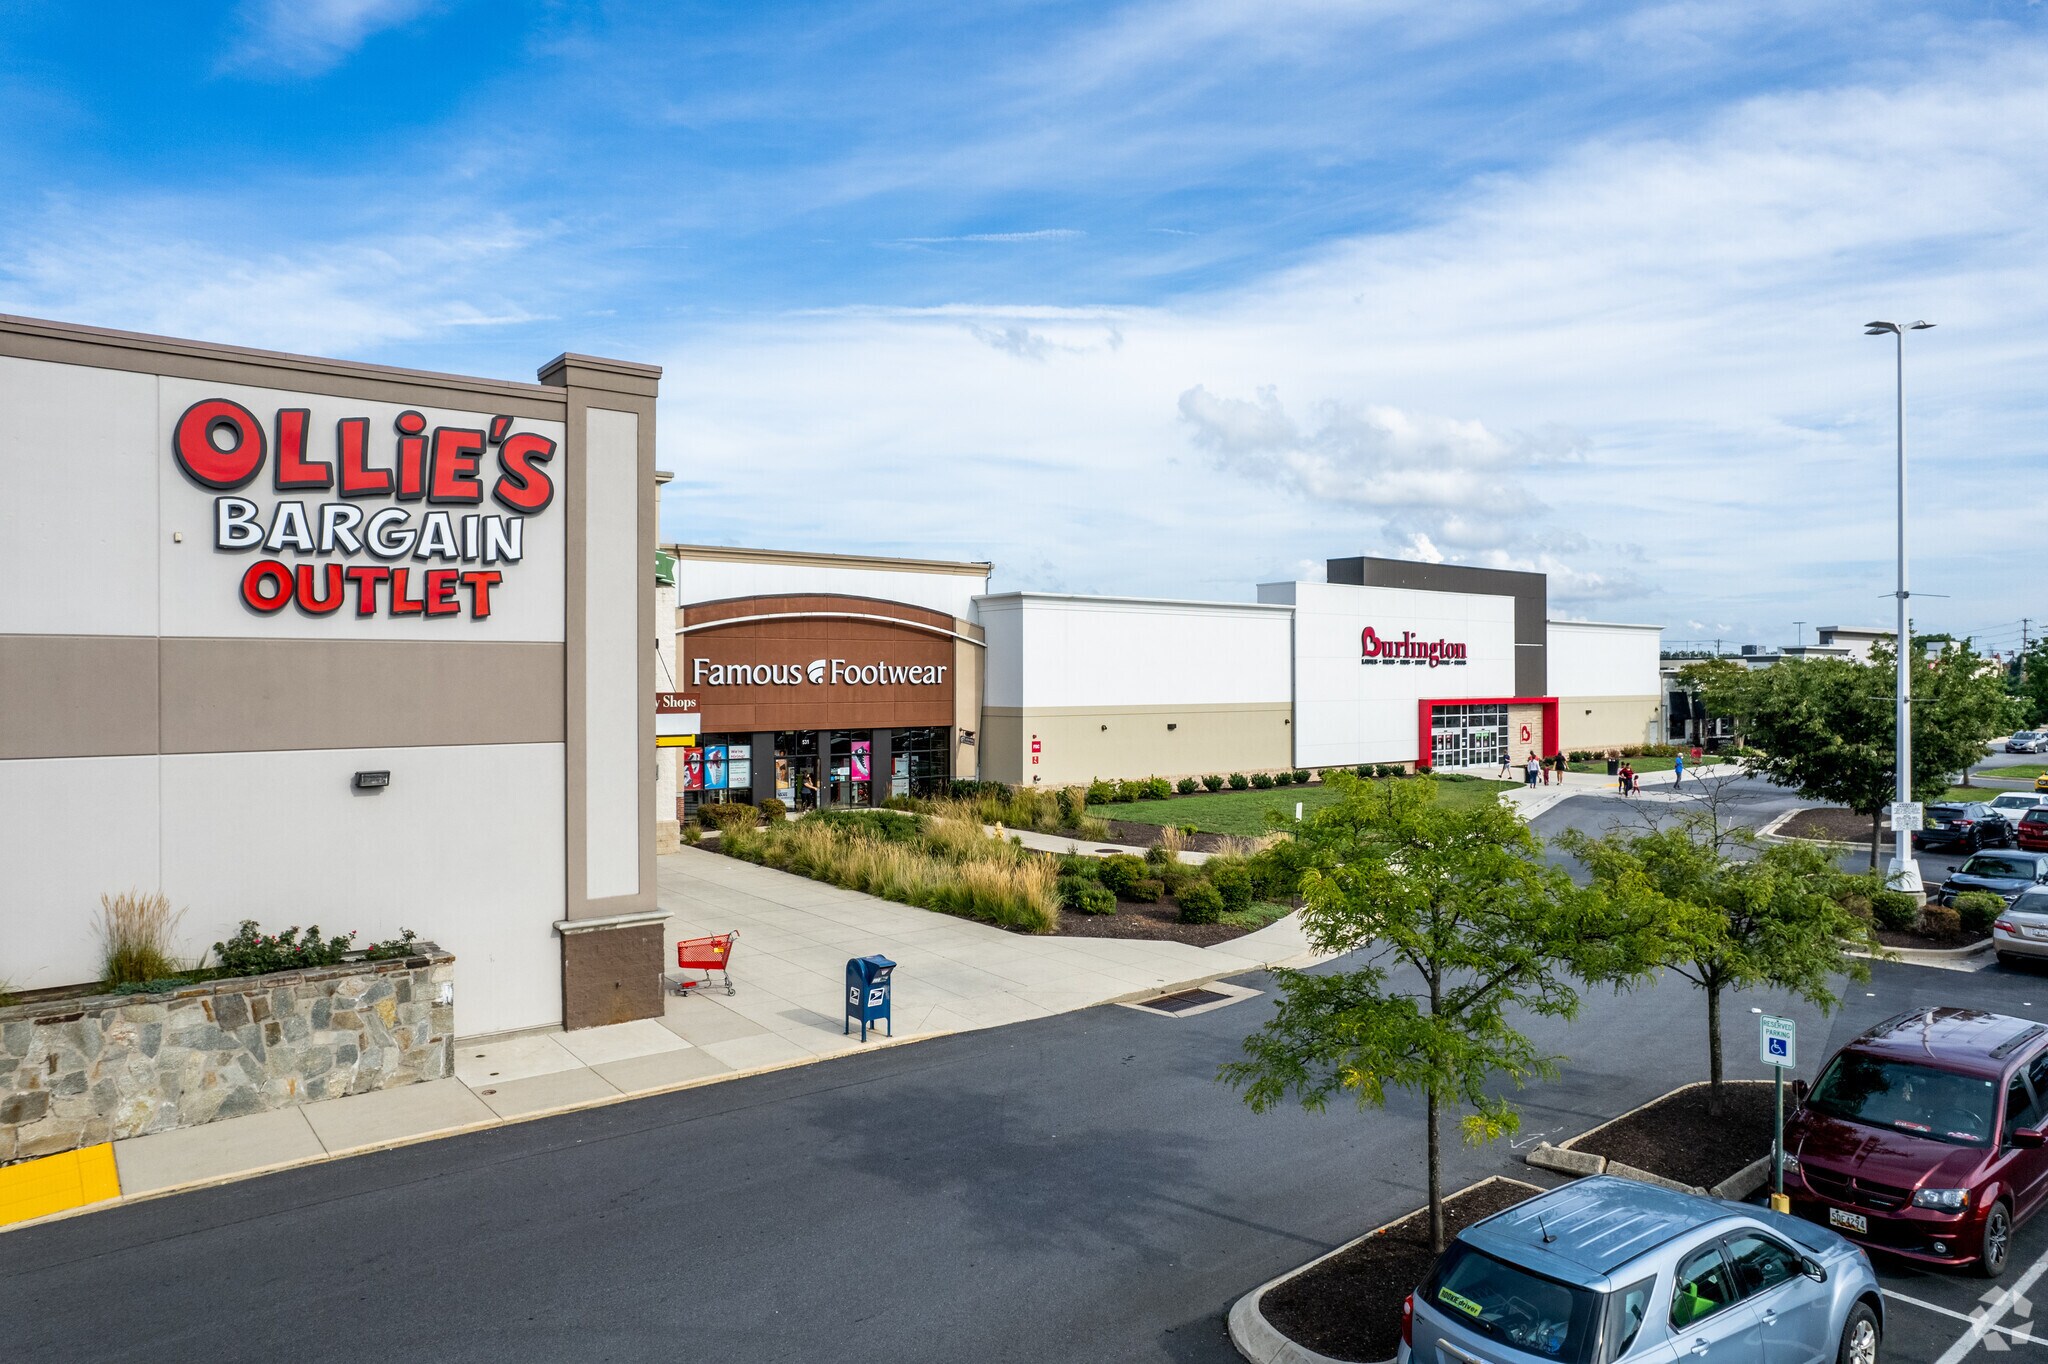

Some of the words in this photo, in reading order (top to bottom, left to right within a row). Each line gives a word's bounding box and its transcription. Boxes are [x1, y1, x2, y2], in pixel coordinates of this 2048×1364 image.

[215, 496, 524, 563] BARGAIN
[240, 560, 502, 618] OUTLET
[1361, 626, 1468, 668] Burlington
[692, 658, 802, 686] Famous
[829, 658, 947, 685] Footwear
[662, 694, 697, 711] Shops
[1763, 1019, 1792, 1031] RESERVED
[1765, 1028, 1790, 1039] PARKING
[1459, 1301, 1478, 1314] driver
